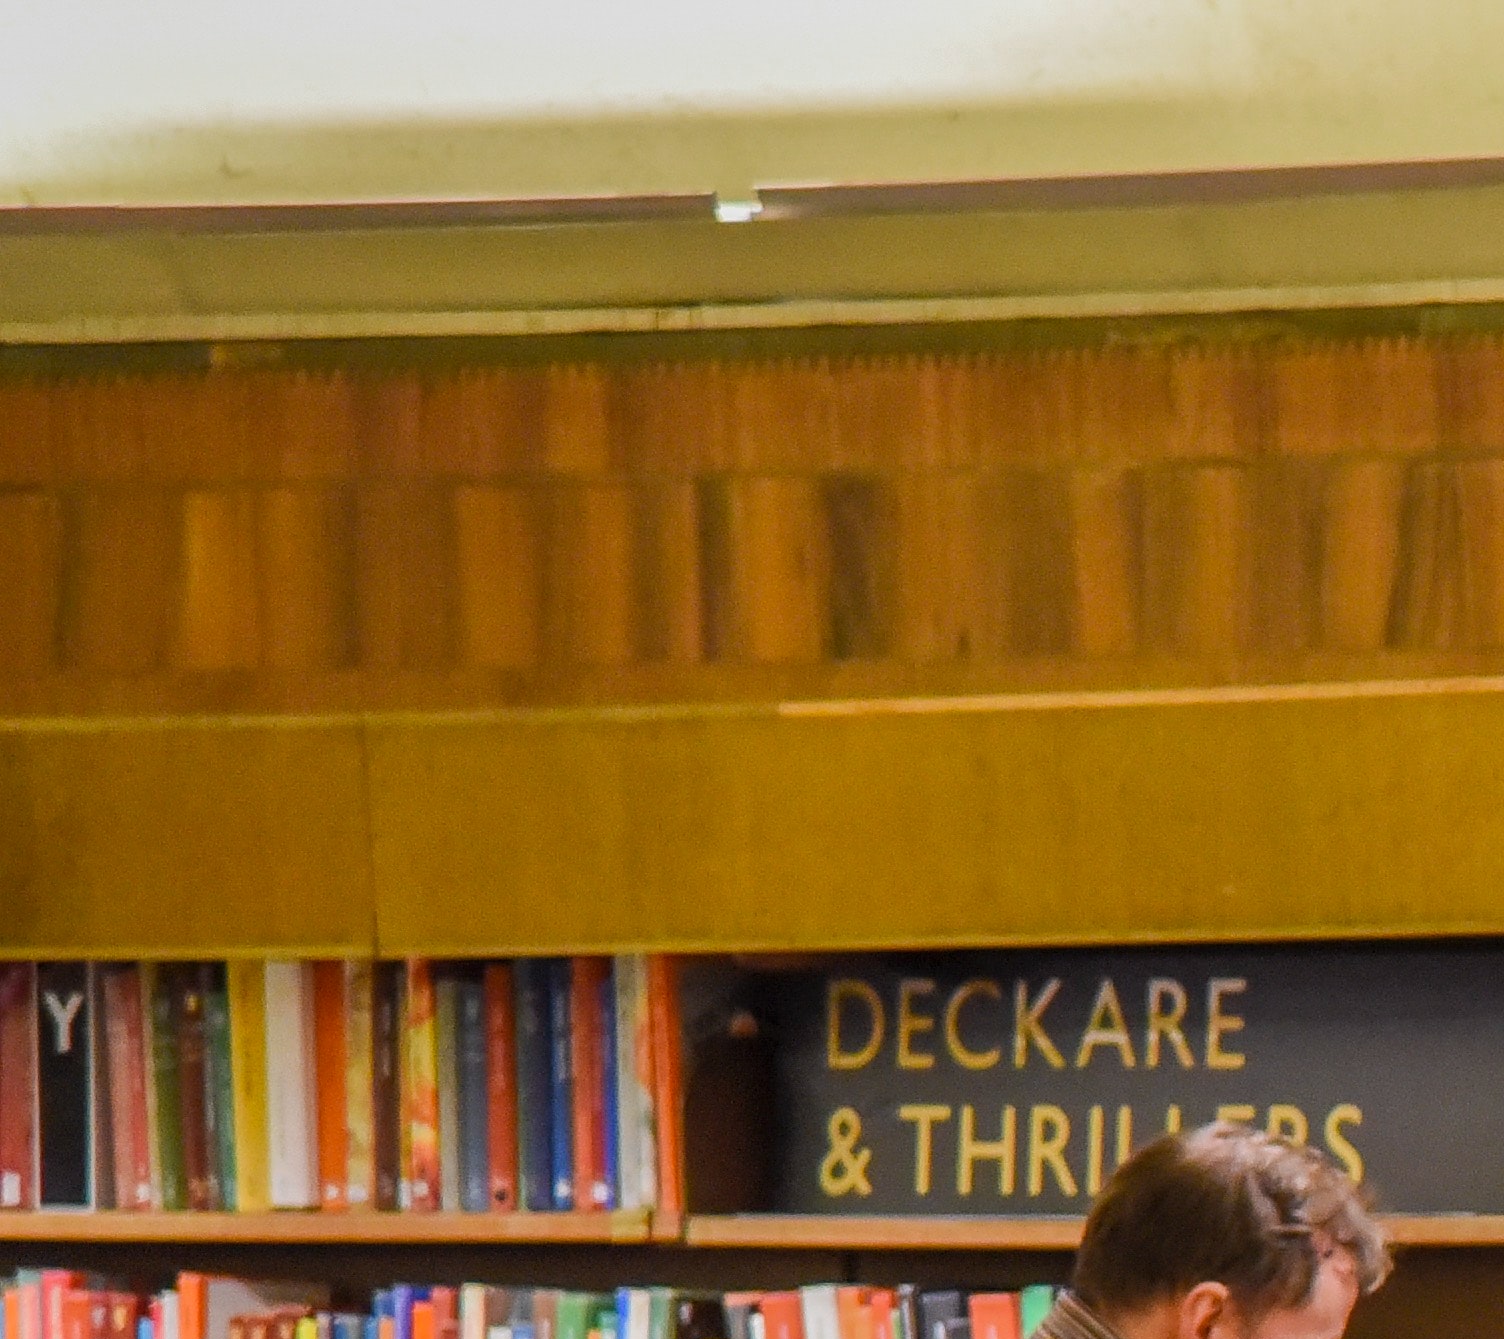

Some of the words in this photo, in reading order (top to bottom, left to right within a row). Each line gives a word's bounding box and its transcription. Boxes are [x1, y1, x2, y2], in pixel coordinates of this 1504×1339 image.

[44, 991, 84, 1056] Y
[826, 977, 1248, 1071] DECKARE
[818, 1104, 872, 1198] &
[898, 1103, 1365, 1197] THRIS
